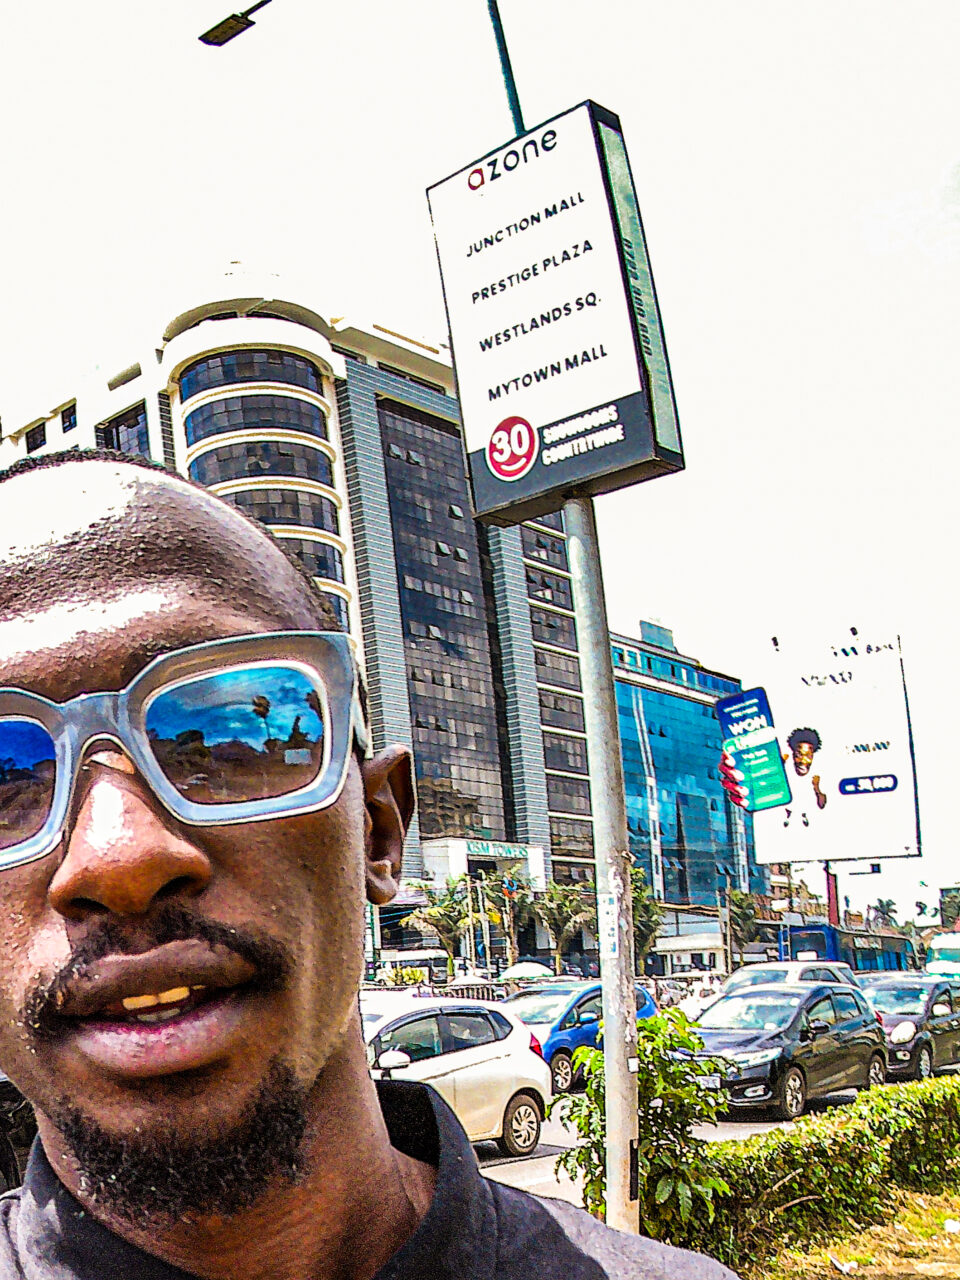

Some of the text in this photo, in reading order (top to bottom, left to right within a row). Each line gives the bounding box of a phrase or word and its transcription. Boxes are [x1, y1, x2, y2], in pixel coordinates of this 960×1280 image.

[467, 129, 557, 191] azone
[466, 192, 585, 258] JUNCTION MALL
[471, 239, 593, 305] PRESTIGE PLAZA
[479, 292, 602, 352] WESTLANDS SQ.
[488, 344, 608, 402] MYTOWN MALL
[491, 423, 530, 463] 30
